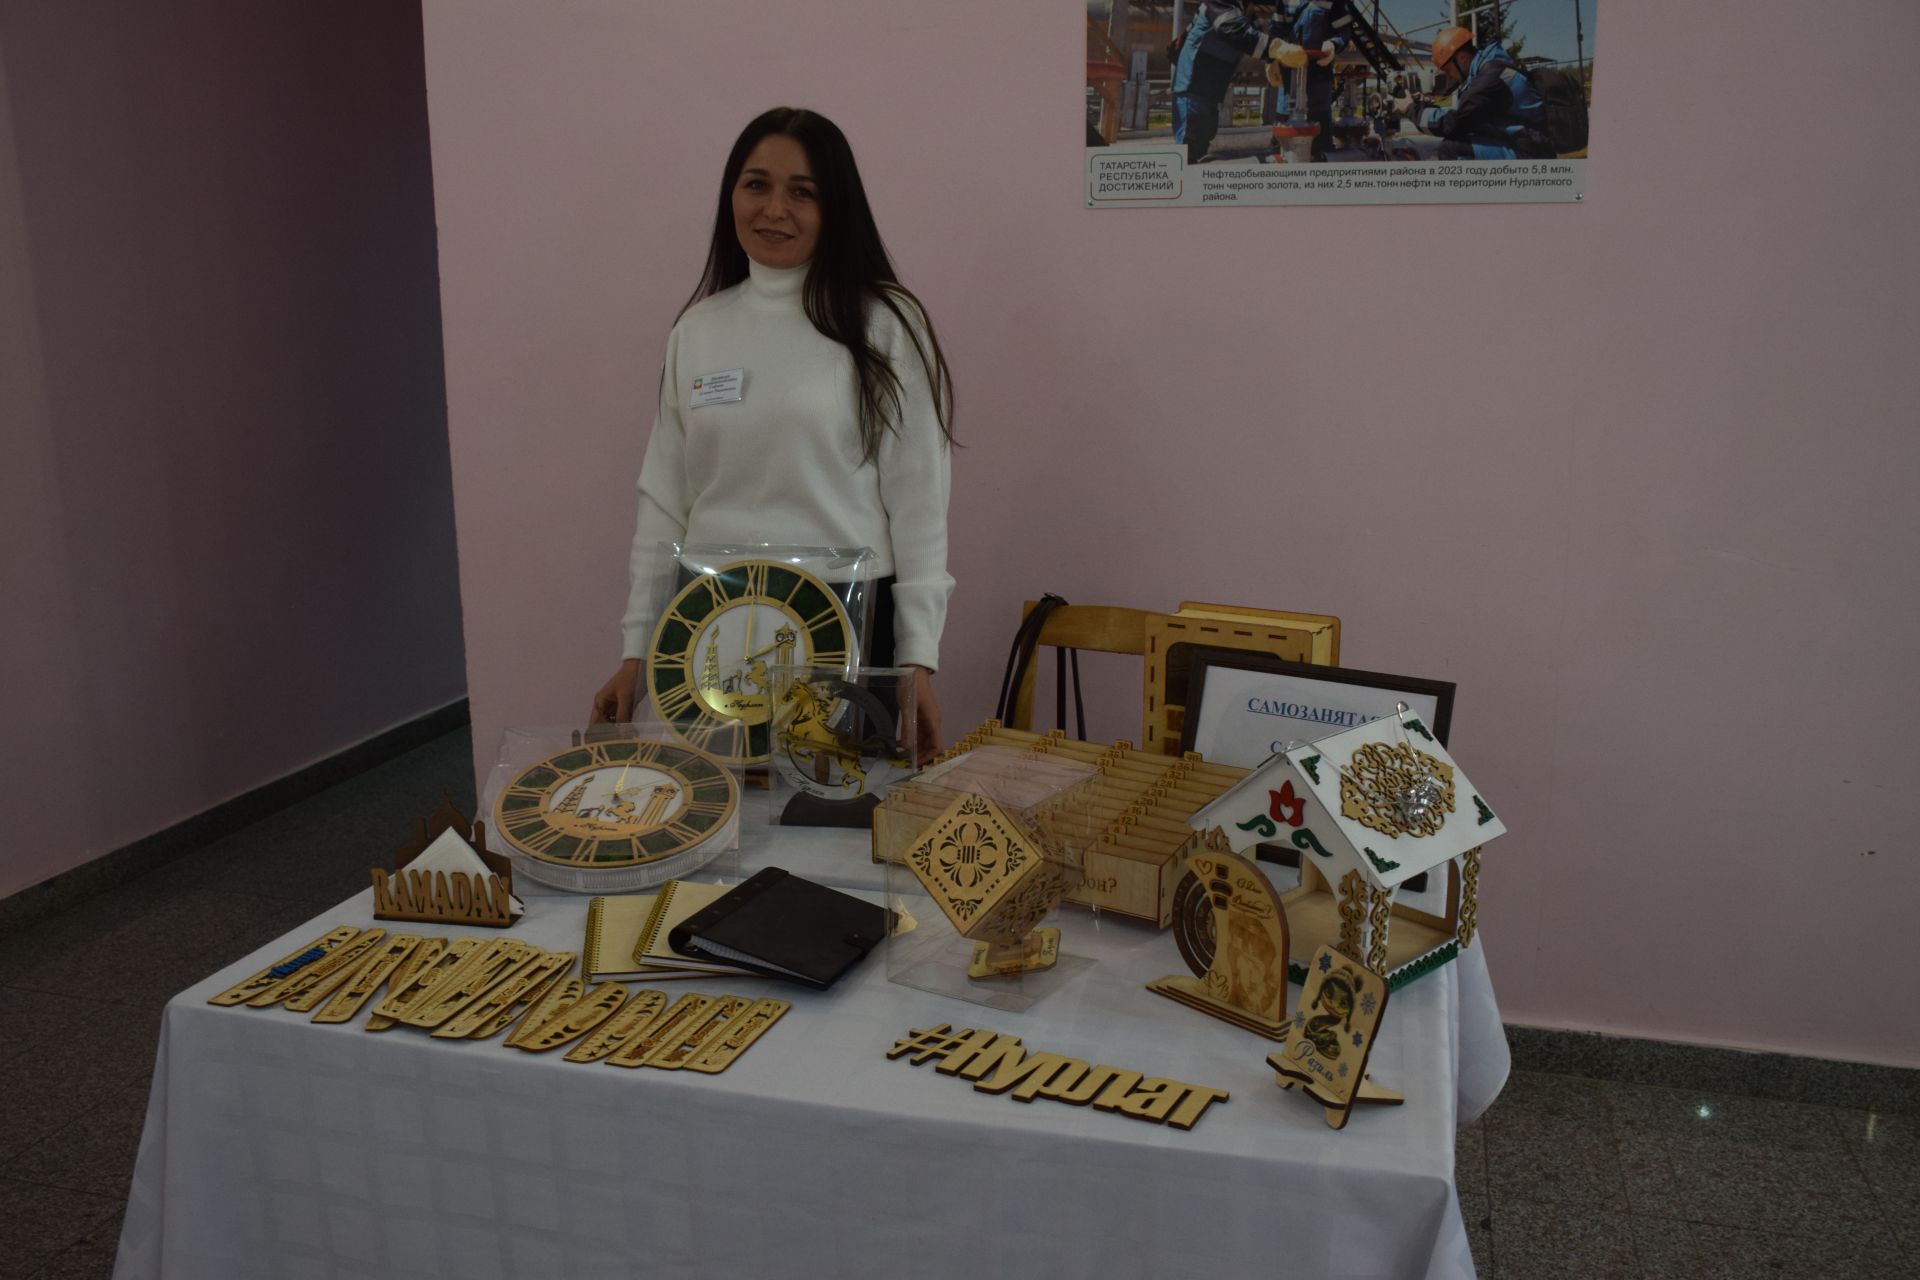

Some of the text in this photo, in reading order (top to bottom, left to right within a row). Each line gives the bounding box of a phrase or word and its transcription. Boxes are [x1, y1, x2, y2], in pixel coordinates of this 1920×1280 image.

[1099, 161, 1156, 171] ТАТАРСТАН
[1203, 168, 1307, 180] Нефтедобывающими
[1309, 168, 1387, 179] предприятиями
[1390, 166, 1426, 177] района
[1438, 165, 1463, 176] 2023
[1465, 167, 1487, 178] году
[1489, 165, 1529, 176] добыто
[1531, 165, 1548, 175] 5,8
[1550, 166, 1574, 175] млн.
[1099, 171, 1169, 182] РЕСПУБЛИКА
[1099, 181, 1174, 193] ДОСТИЖЕНИЙ
[1203, 182, 1225, 190] тонн
[1227, 181, 1264, 191] черного
[1266, 180, 1301, 191] золота,
[1304, 181, 1316, 189] из
[1317, 181, 1335, 189] них
[1337, 179, 1352, 189] 2,5
[1433, 179, 1446, 188] на
[1449, 178, 1507, 189] территории
[1509, 177, 1573, 188] Нурлатского
[1203, 192, 1238, 202] района.
[1248, 697, 1380, 726] САМОЗАНЯТА
[370, 867, 511, 919] RAMADAN
[1294, 1040, 1335, 1083] Разиль
[886, 1023, 1230, 1131] #Нурлат
